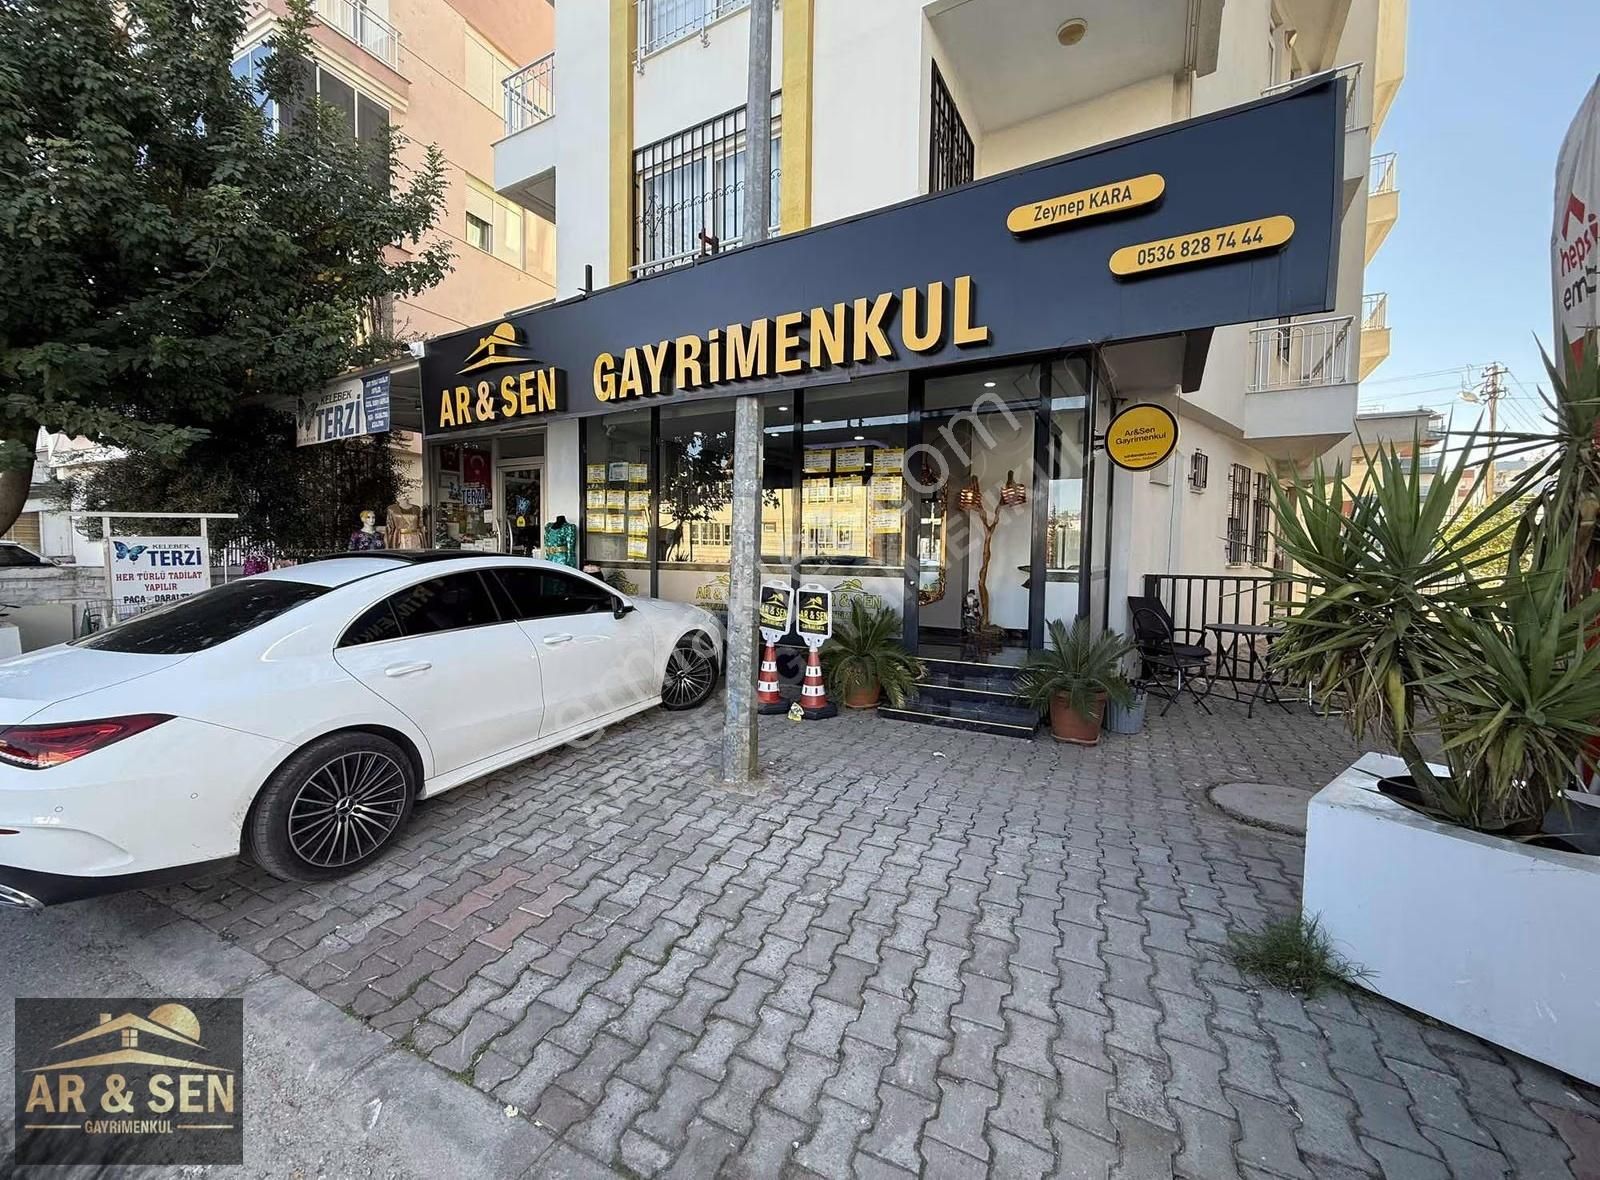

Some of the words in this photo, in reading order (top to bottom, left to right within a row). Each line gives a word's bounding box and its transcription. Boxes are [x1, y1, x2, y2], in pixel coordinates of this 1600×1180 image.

[1033, 199, 1085, 223] Zeynep
[1089, 185, 1133, 209] KARA
[1137, 246, 1176, 266] 0536
[1180, 238, 1211, 259] 828
[1216, 232, 1237, 251] 74
[1242, 225, 1264, 245] 44
[320, 389, 353, 406] KELEBEK
[439, 385, 472, 428] AR
[475, 380, 496, 422] &
[500, 366, 557, 418] SEN
[315, 393, 361, 442] TERZİ
[1115, 432, 1167, 445] Gayrimenkul
[1124, 427, 1156, 437] Ar&Sen
[146, 547, 202, 566] TERZİ
[115, 572, 135, 582] HER
[136, 570, 166, 581] TÜRLÜ
[167, 570, 203, 580] TADİLAT
[144, 582, 178, 592] YAPILIR
[123, 595, 146, 605] PAÇA
